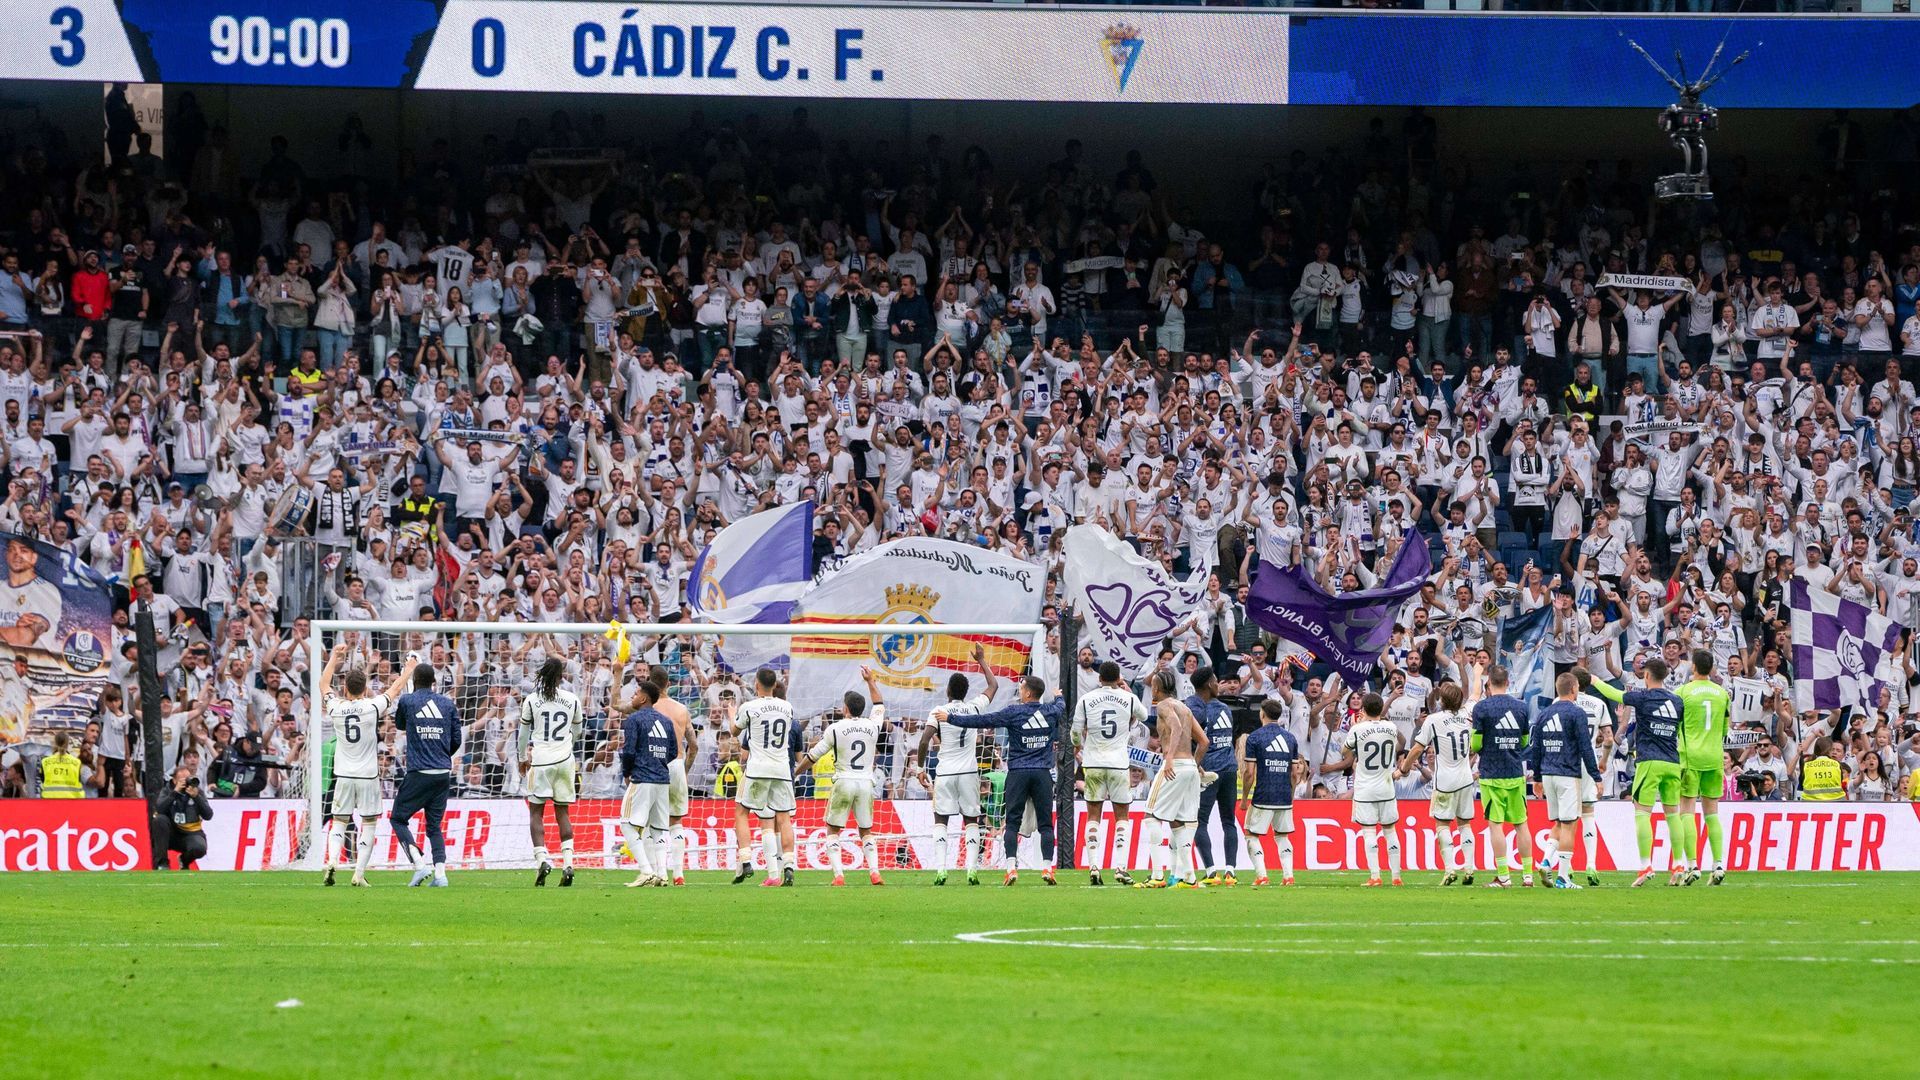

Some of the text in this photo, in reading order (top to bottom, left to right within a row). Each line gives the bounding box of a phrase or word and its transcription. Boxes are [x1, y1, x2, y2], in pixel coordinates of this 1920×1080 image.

[50, 6, 86, 67] 3
[209, 15, 349, 68] 90:00
[573, 9, 883, 81] CÁDIZ C. F.
[472, 17, 506, 77] 0
[443, 258, 463, 280] 18
[1614, 274, 1676, 288] Madridista
[443, 429, 505, 441] Real Madrid
[1624, 423, 1645, 434] Real
[1088, 695, 1129, 709] BELLINGHAM
[1742, 693, 1754, 712] 11
[1100, 709, 1117, 739] 5
[1702, 700, 1713, 731] 1
[344, 715, 361, 743] 6
[415, 725, 444, 734] Emirates
[541, 711, 569, 742] 12
[761, 718, 787, 749] 19
[842, 725, 874, 737] CARVAJAL
[1359, 727, 1376, 741] FRAN
[1649, 722, 1676, 731] Emirates
[1021, 735, 1050, 743] Emirates
[1447, 729, 1470, 760] 10
[850, 740, 866, 770] 2
[1363, 740, 1395, 771] 20
[1806, 760, 1839, 768] SEGURIDAD
[53, 767, 69, 776] 671
[233, 772, 243, 784] 19
[1814, 771, 1833, 779] 1513
[1726, 812, 1887, 871] BETTER
